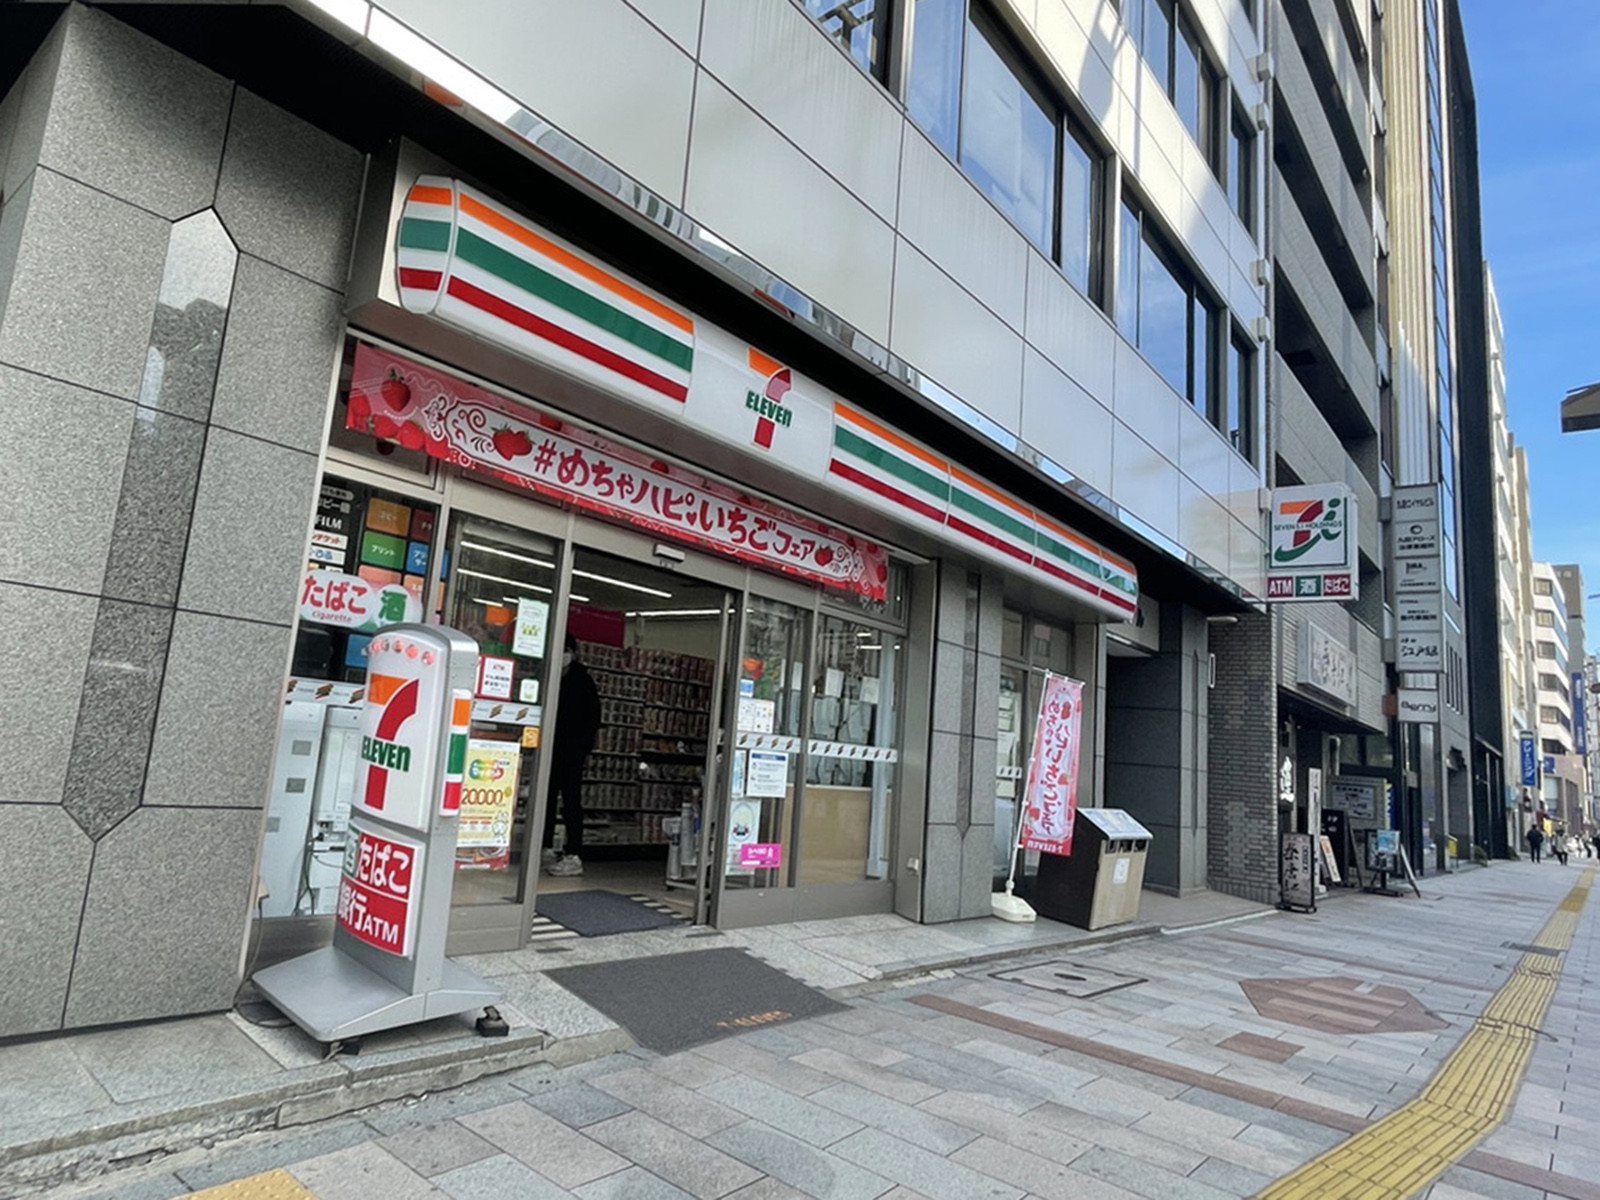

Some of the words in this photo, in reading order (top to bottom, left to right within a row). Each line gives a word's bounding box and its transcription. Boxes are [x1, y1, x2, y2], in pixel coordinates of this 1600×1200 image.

[1269, 579, 1292, 595] ATM
[1300, 578, 1317, 594] 酒
[1324, 577, 1350, 594] たばこ
[301, 575, 368, 615] たばこ
[355, 836, 410, 893] たばこ
